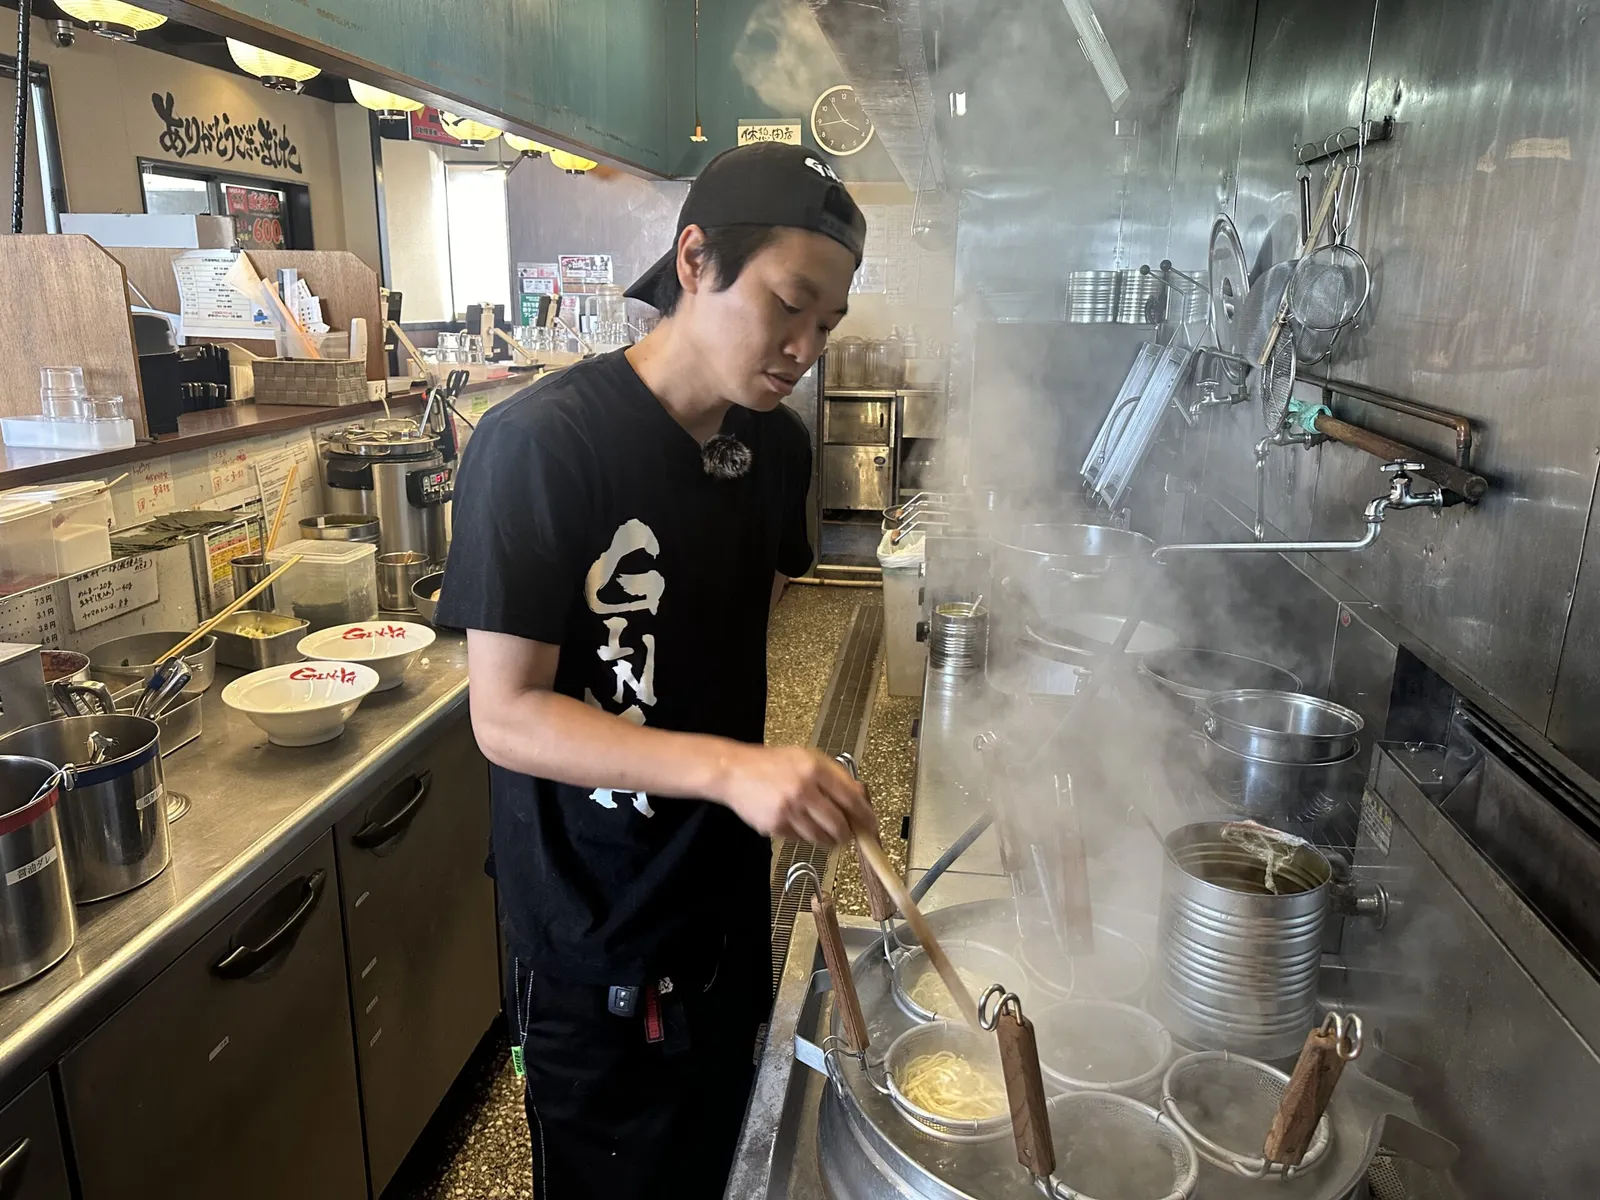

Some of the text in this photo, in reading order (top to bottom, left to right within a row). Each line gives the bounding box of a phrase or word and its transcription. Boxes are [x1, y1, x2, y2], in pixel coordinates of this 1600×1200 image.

[152, 92, 302, 174] ありがとうございました
[253, 217, 282, 245] 600
[35, 594, 53, 606] 7.3円
[37, 607, 55, 619] 3.1円
[38, 620, 56, 632] 3.8円
[289, 667, 356, 685] GIN-YA
[17, 856, 51, 879] 醤油ダレ
